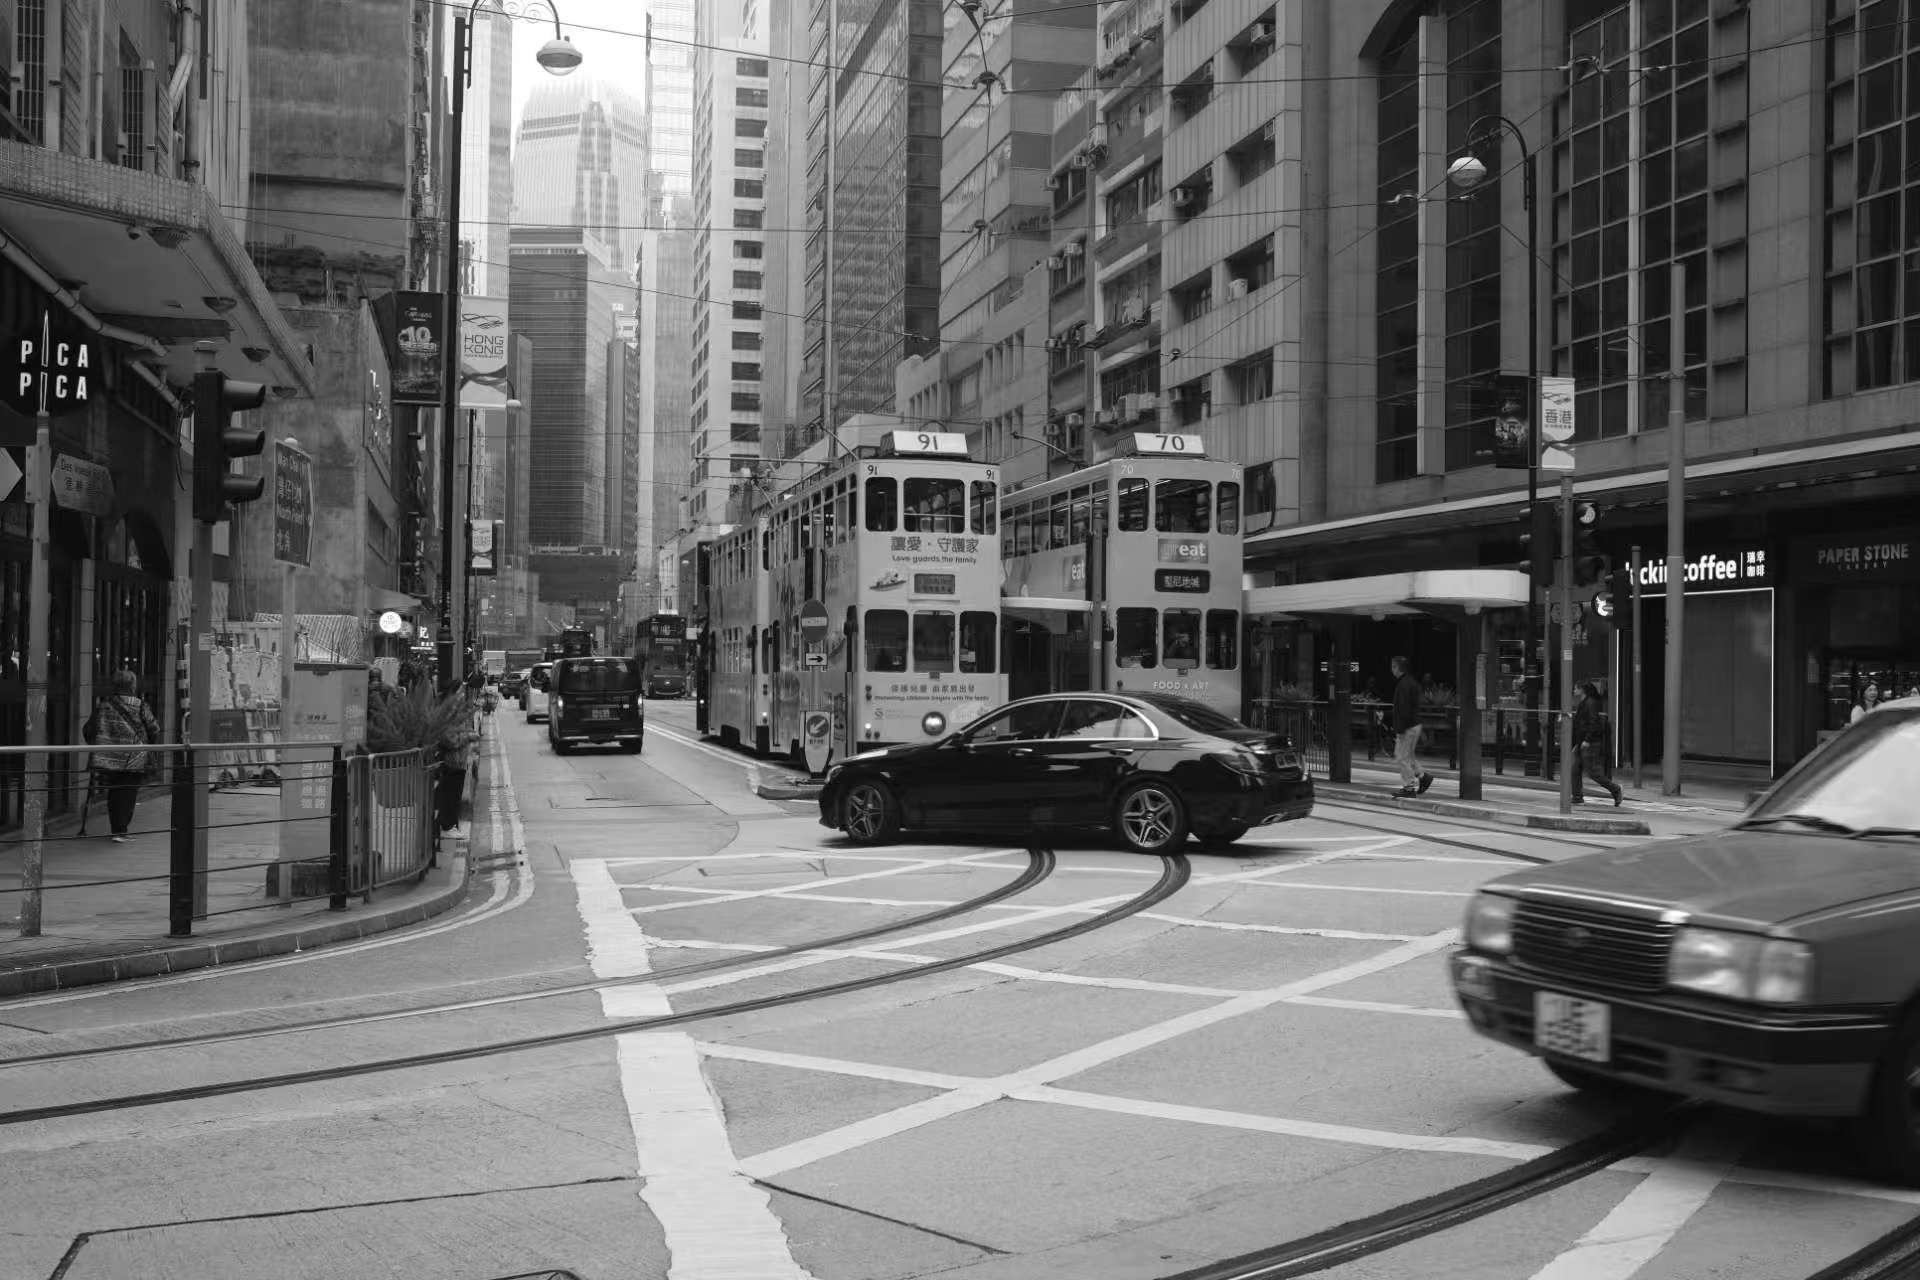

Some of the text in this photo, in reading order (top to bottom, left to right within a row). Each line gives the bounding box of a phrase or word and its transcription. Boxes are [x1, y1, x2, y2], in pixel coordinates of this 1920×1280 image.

[464, 334, 504, 345] HONG
[464, 345, 504, 355] KONG
[917, 434, 938, 451] 91
[1155, 434, 1185, 451] 70
[867, 464, 878, 475] 91
[986, 469, 995, 480] 91
[1120, 464, 1134, 475] 70
[1231, 468, 1241, 479] 70
[912, 555, 940, 564] guards
[941, 555, 953, 563] the
[1817, 543, 1909, 565] PAPER STONE
[1747, 564, 1766, 577] 咖啡
[1153, 681, 1181, 690] FOOD
